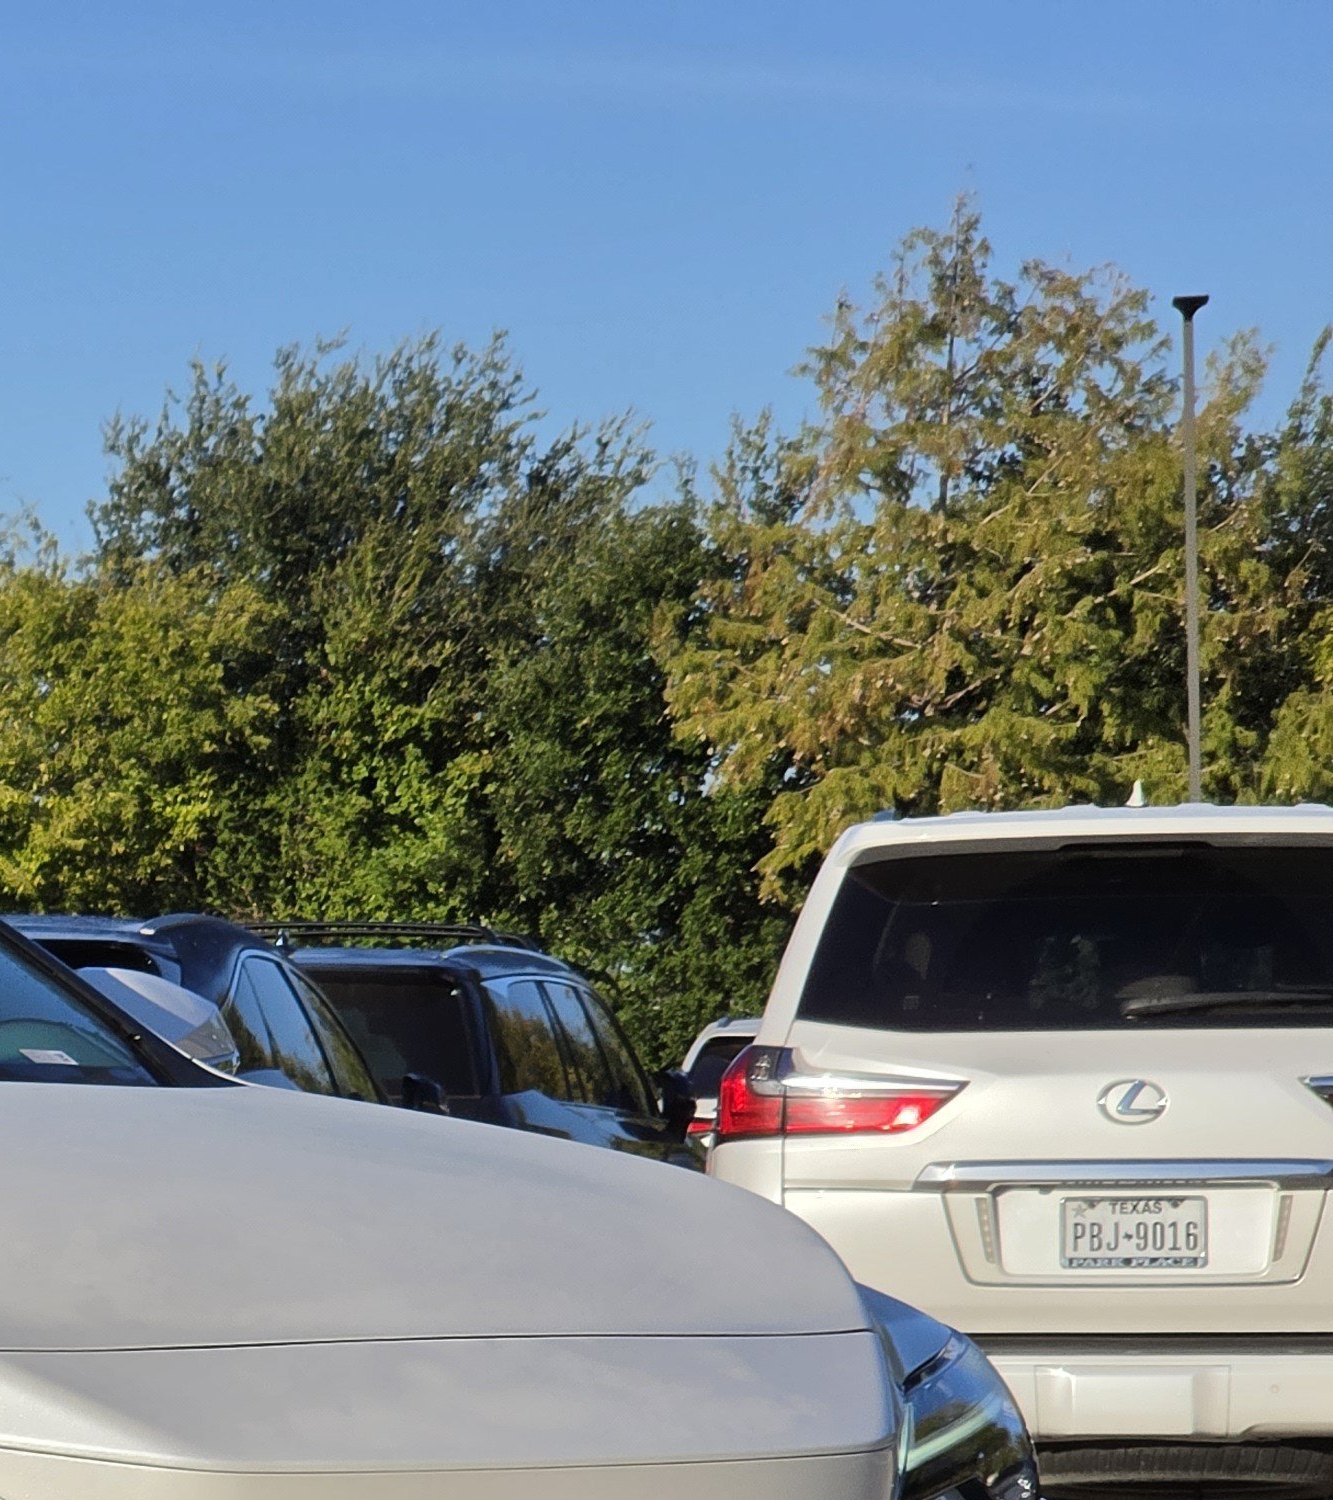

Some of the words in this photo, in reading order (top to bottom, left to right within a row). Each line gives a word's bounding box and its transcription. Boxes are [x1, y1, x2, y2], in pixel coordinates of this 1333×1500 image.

[1108, 1202, 1163, 1215] TEXAS
[1072, 1257, 1123, 1268] PARK
[1131, 1257, 1195, 1268] PLACE
